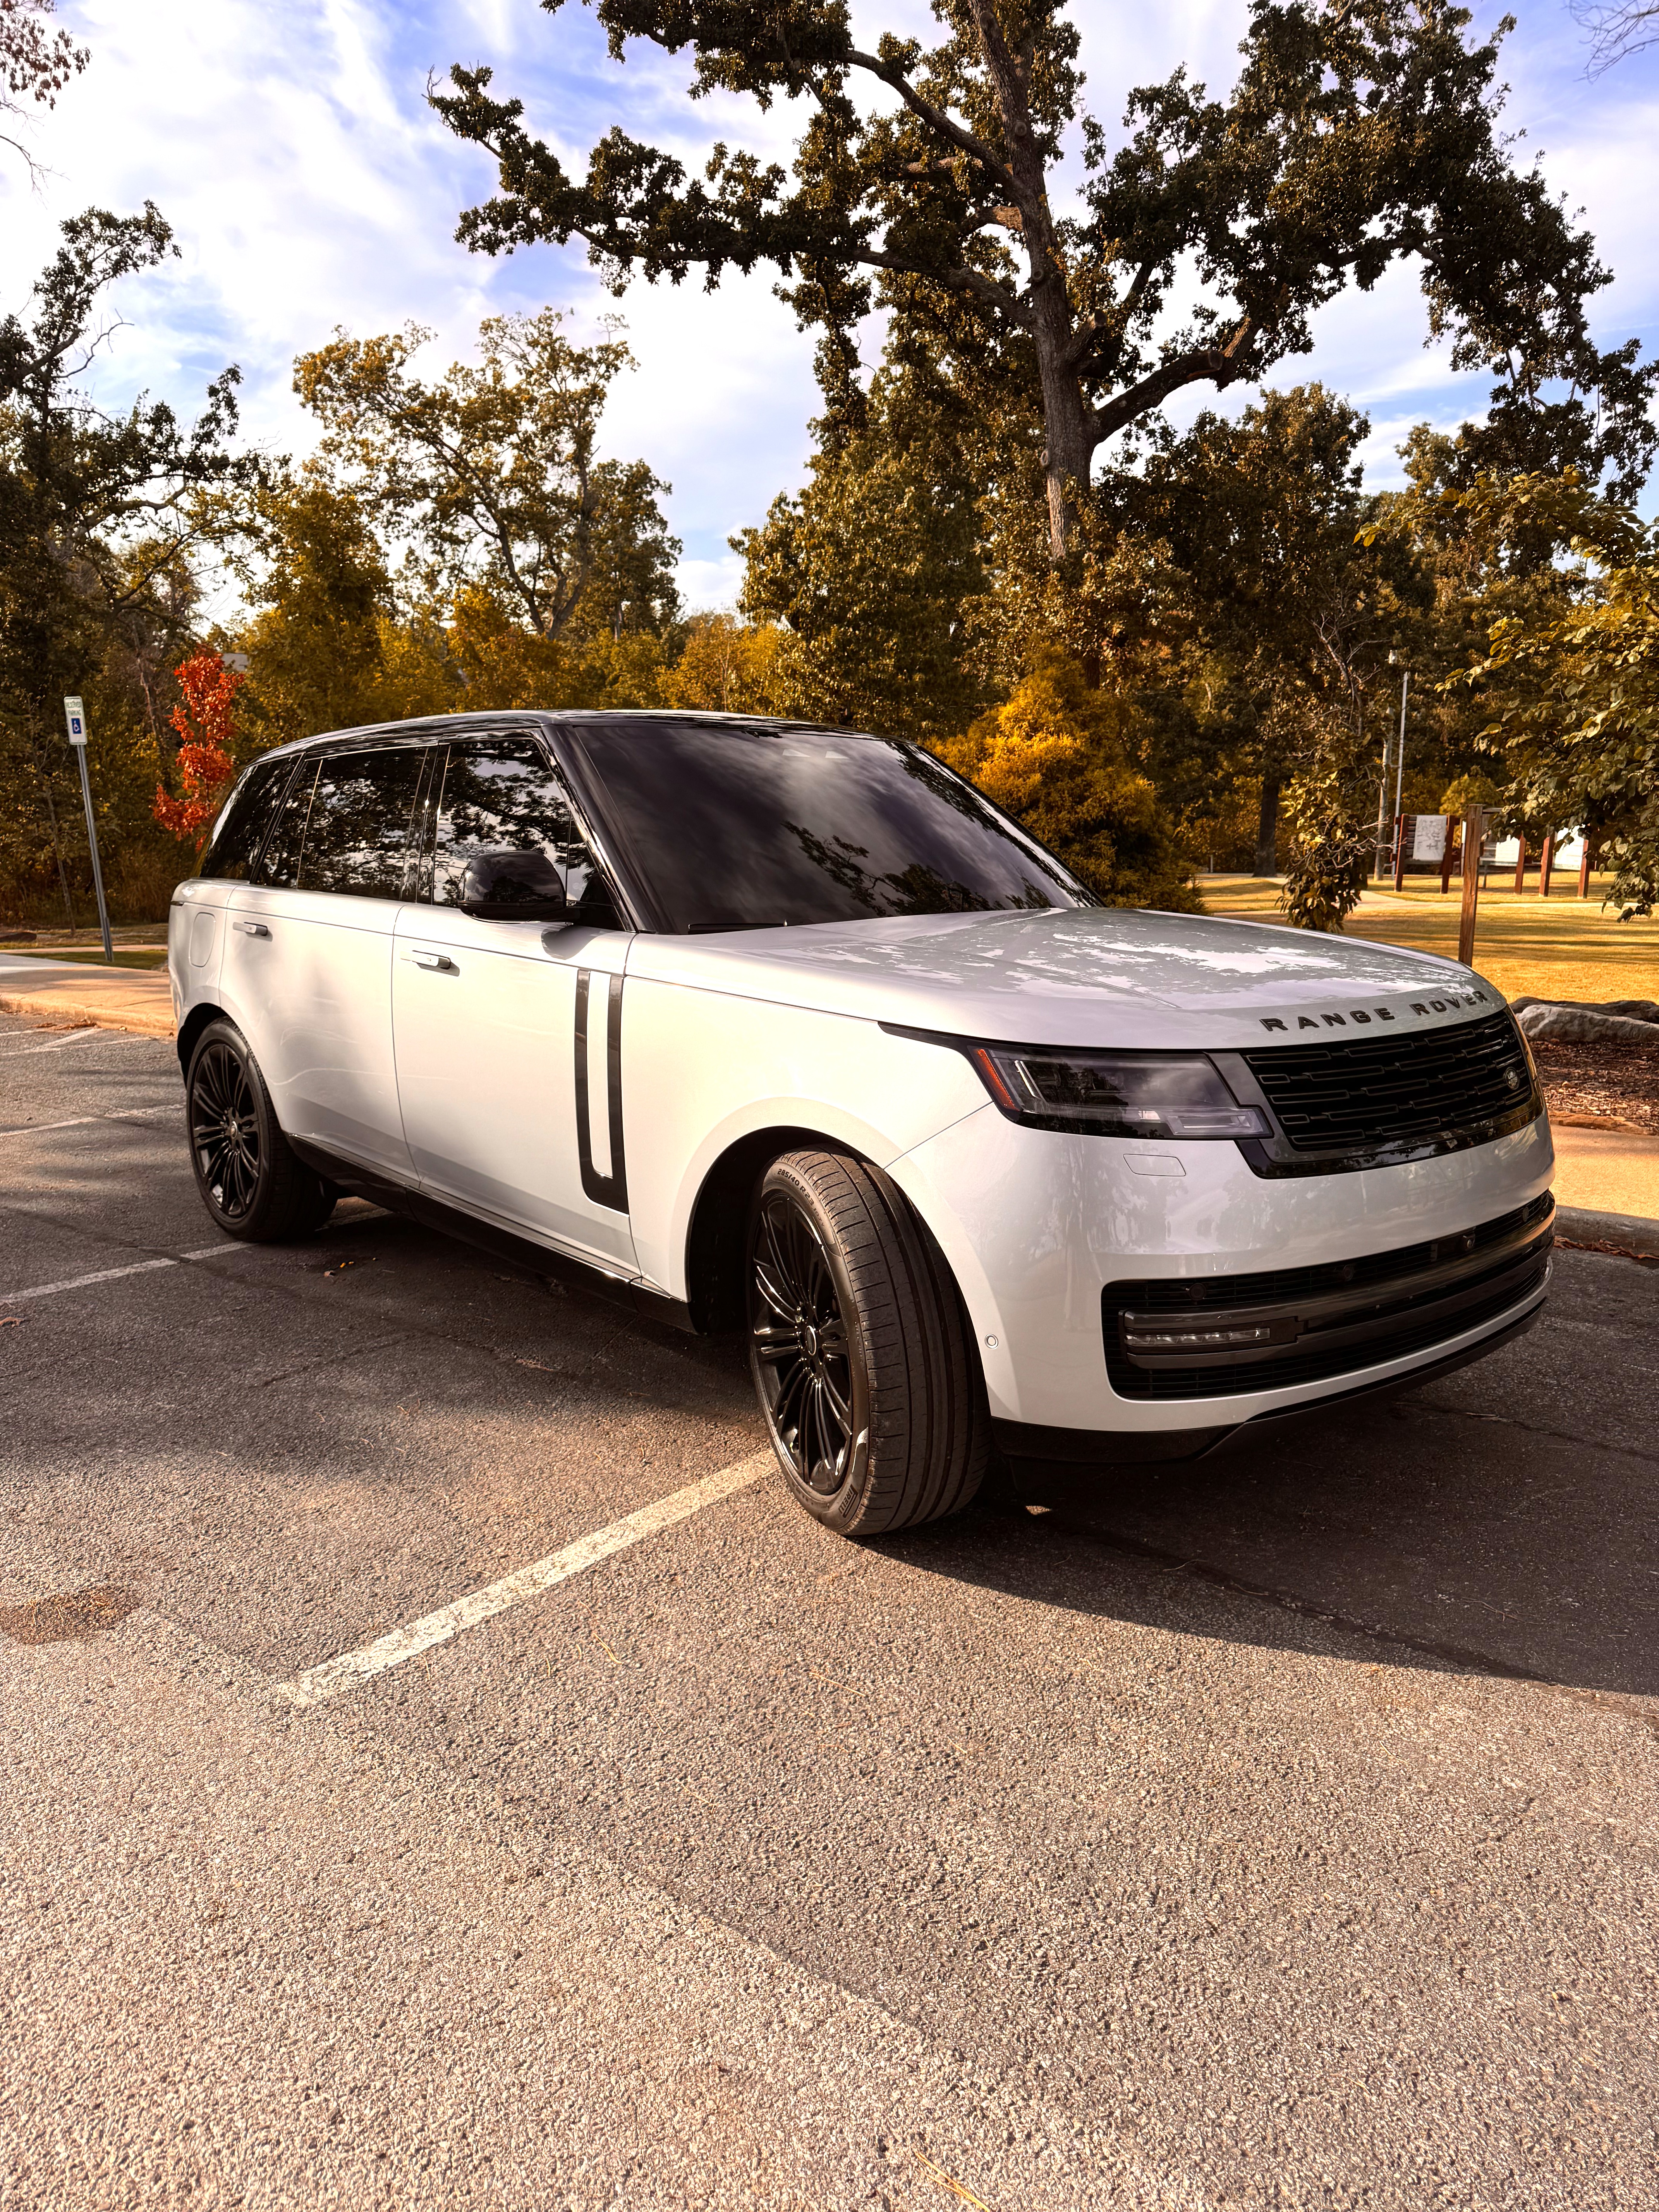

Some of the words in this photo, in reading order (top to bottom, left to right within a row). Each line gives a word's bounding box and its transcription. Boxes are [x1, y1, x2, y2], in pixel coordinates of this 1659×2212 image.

[1259, 1008, 1395, 1031] RANGE
[1409, 991, 1488, 1016] ROVER
[777, 1168, 800, 1186] 285/40
[800, 1185, 814, 1206] R23
[838, 1484, 858, 1518] PIRELLI
